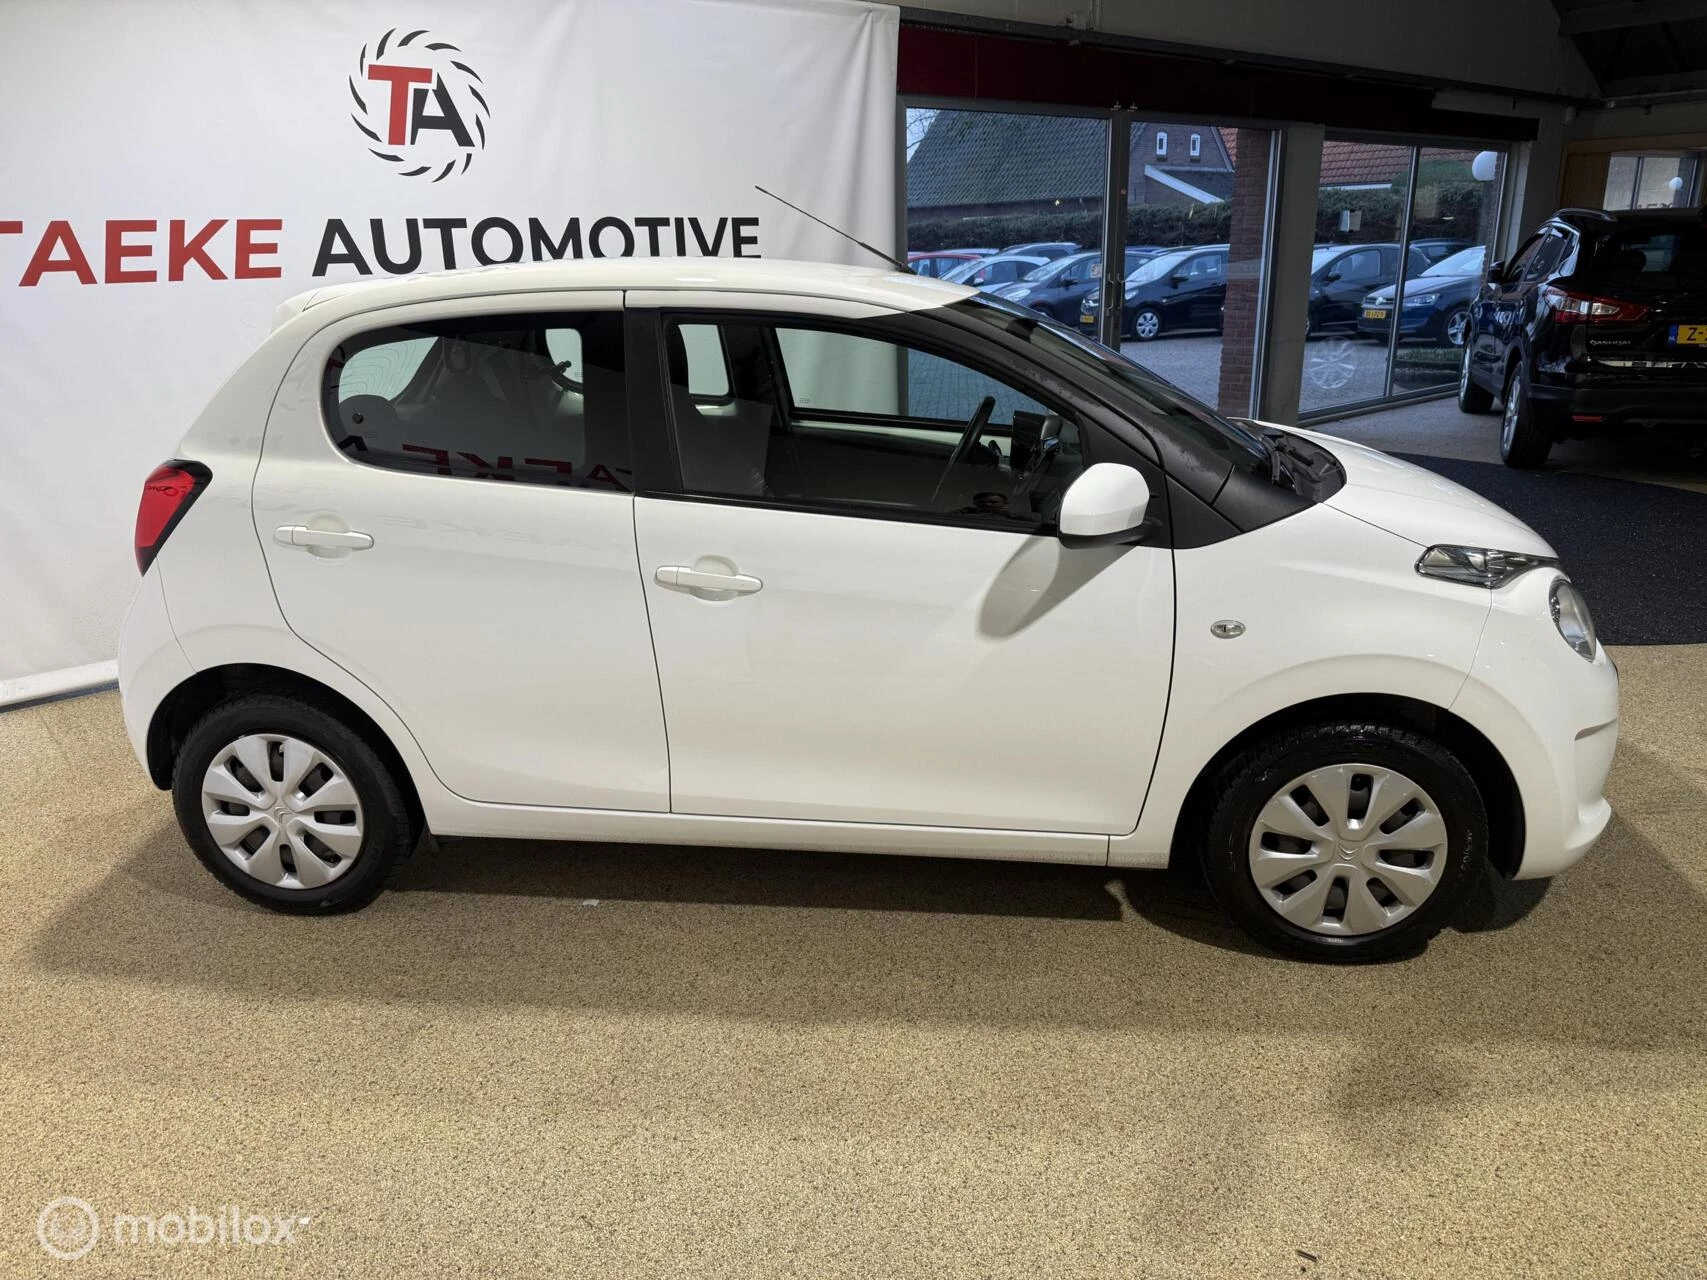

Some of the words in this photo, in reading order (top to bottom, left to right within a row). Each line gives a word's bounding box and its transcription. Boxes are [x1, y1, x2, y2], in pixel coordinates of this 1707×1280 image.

[367, 64, 476, 148] TA
[312, 216, 761, 277] AUTOMOTIVE
[1686, 327, 1707, 341] Z-
